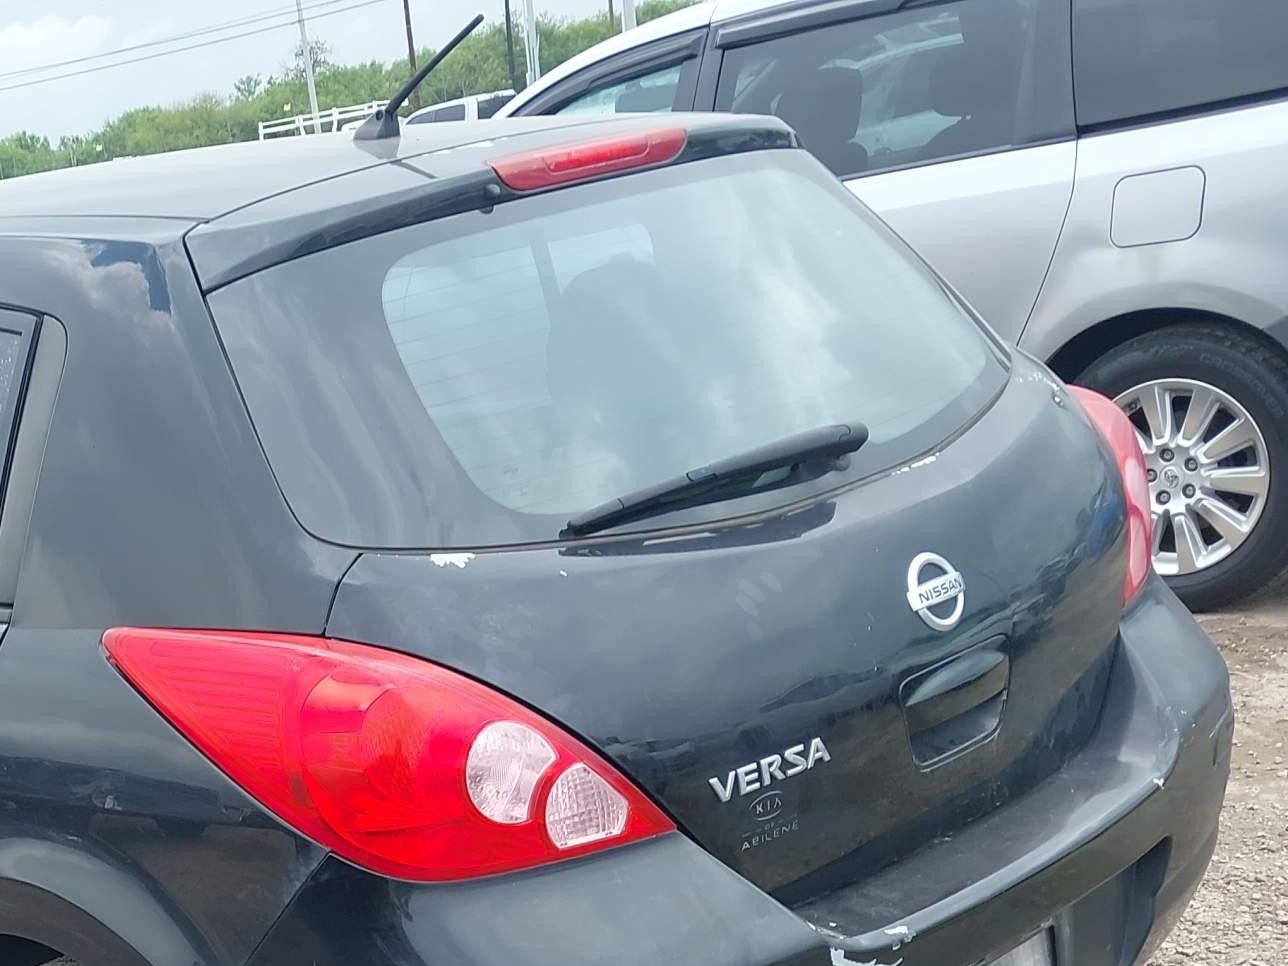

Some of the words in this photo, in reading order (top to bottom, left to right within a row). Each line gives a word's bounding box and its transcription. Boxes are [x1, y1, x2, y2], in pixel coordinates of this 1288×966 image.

[918, 577, 962, 604] NISSAN
[708, 737, 831, 802] VERSA
[755, 798, 782, 815] KIA
[741, 820, 799, 851] ABILENE
